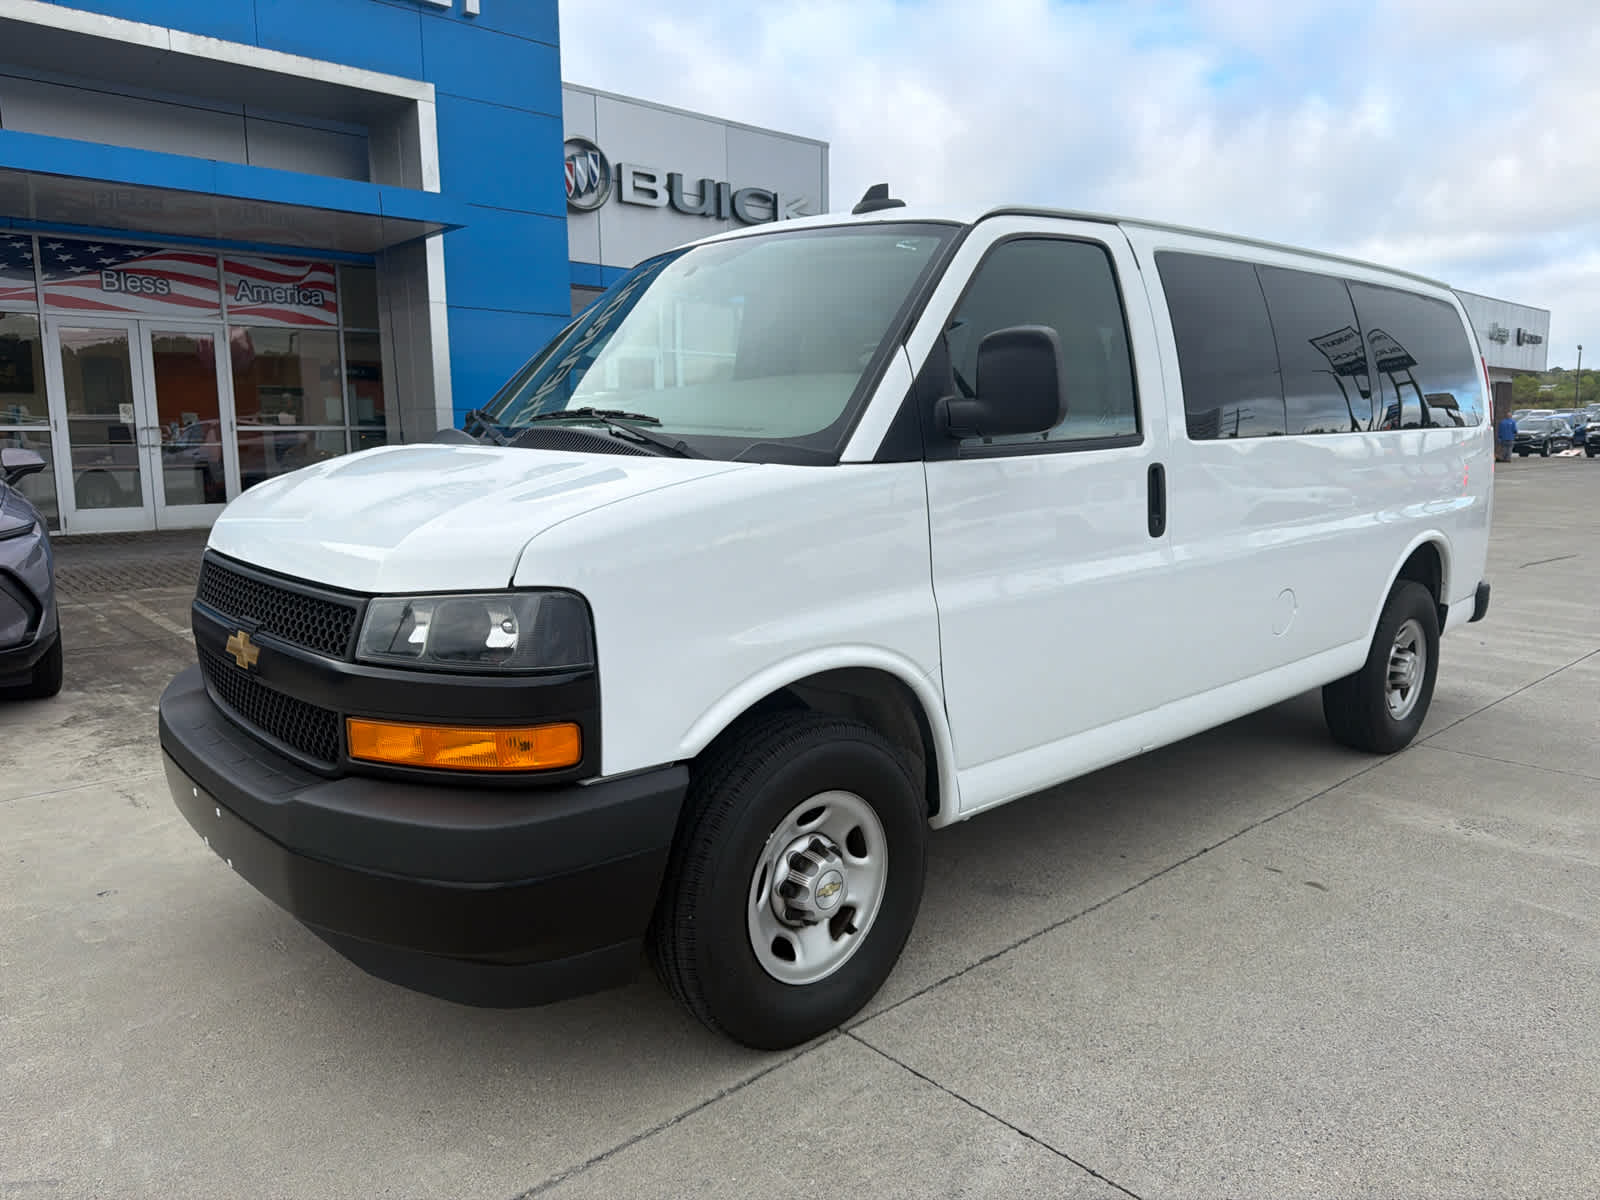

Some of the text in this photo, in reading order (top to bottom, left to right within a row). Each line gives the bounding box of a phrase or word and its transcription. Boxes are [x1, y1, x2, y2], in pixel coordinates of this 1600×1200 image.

[616, 162, 808, 226] BUICK
[100, 270, 324, 306] Bless America
